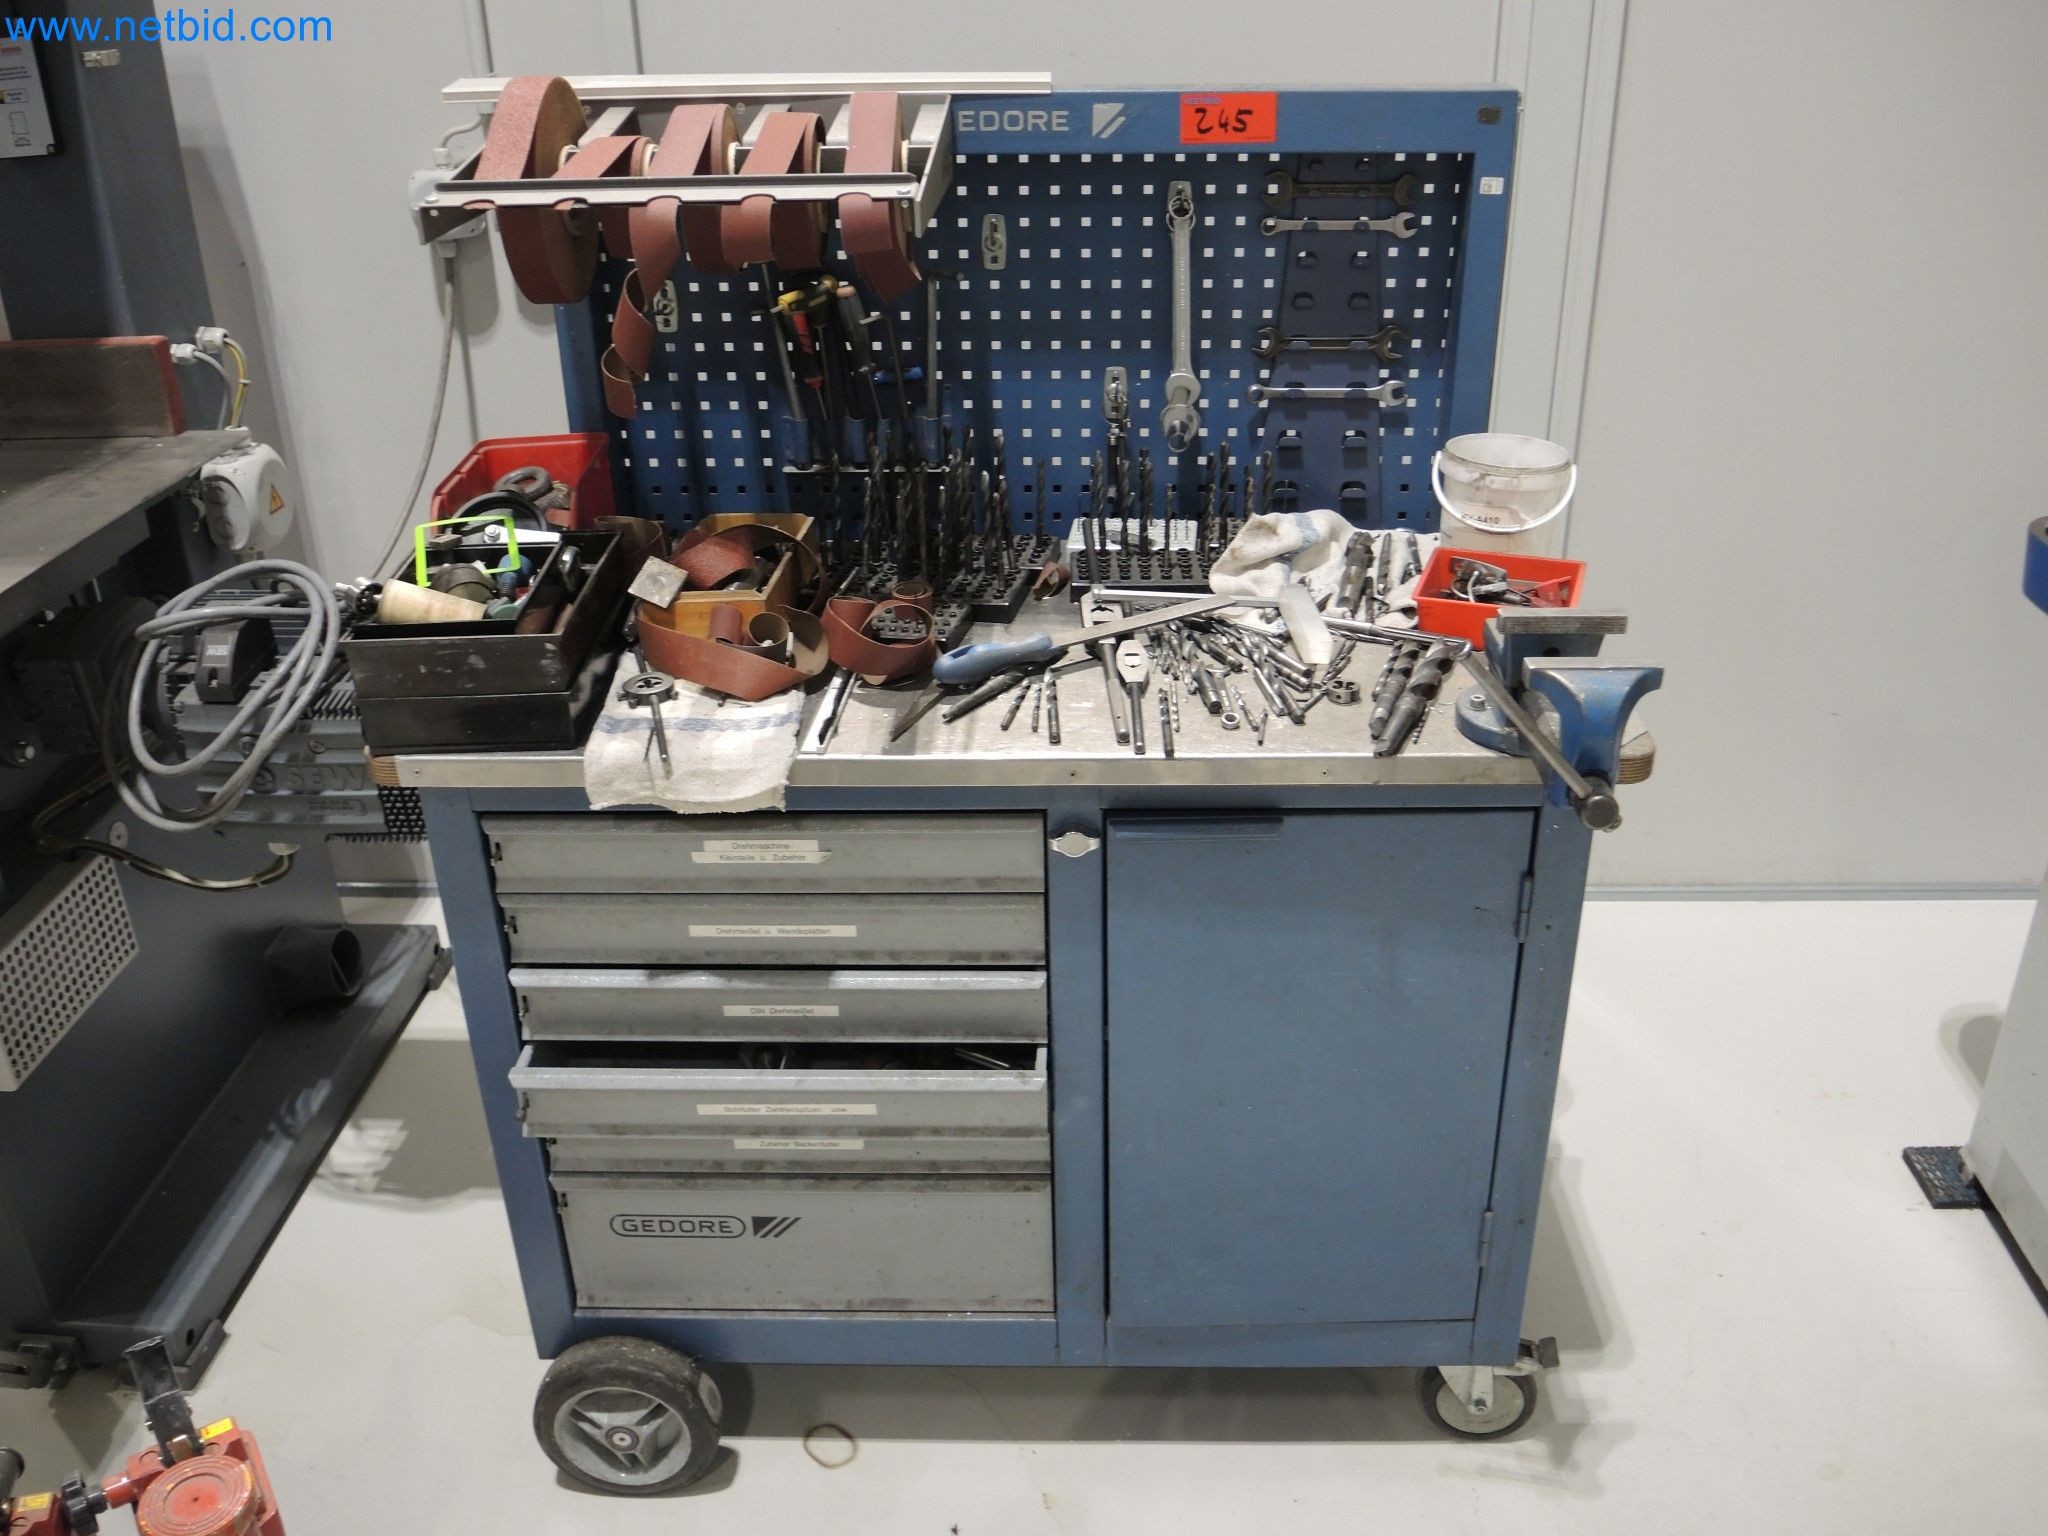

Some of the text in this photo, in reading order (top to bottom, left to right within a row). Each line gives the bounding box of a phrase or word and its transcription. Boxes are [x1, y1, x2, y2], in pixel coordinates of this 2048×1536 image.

[958, 110, 1070, 132] EDORE
[1195, 108, 1254, 135] 245
[621, 1218, 734, 1234] GEDORE
